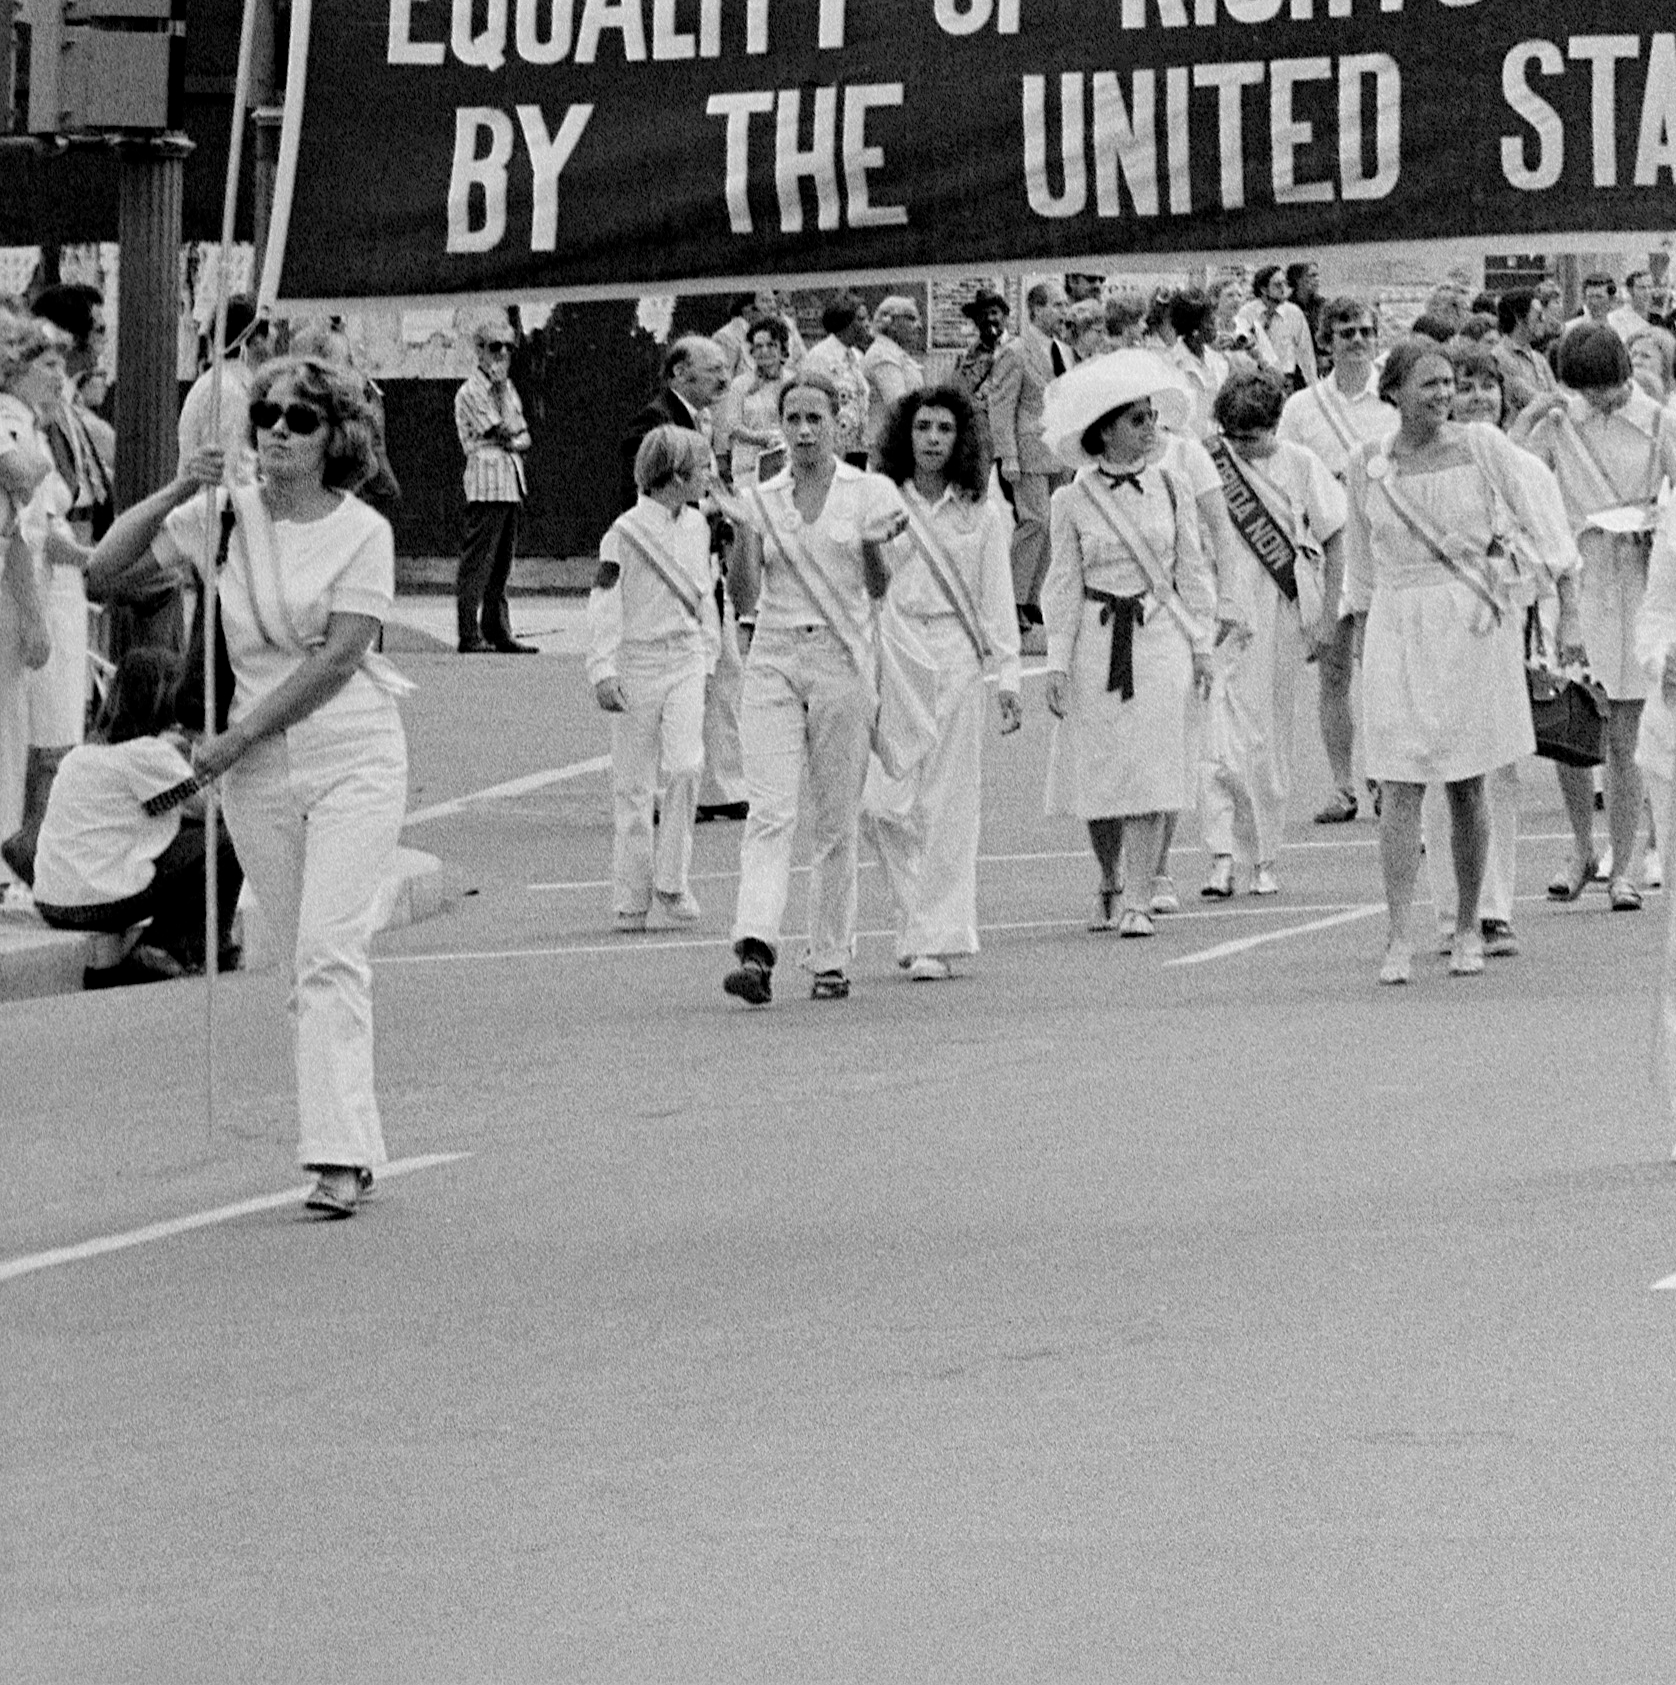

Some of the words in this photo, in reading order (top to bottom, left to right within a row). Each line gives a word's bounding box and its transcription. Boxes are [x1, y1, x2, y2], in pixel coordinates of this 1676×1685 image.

[446, 103, 594, 253] BY
[705, 82, 907, 233] THE
[1022, 52, 1401, 218] UNITED
[1204, 437, 1257, 522] ORIDA
[1244, 516, 1292, 571] NOW
